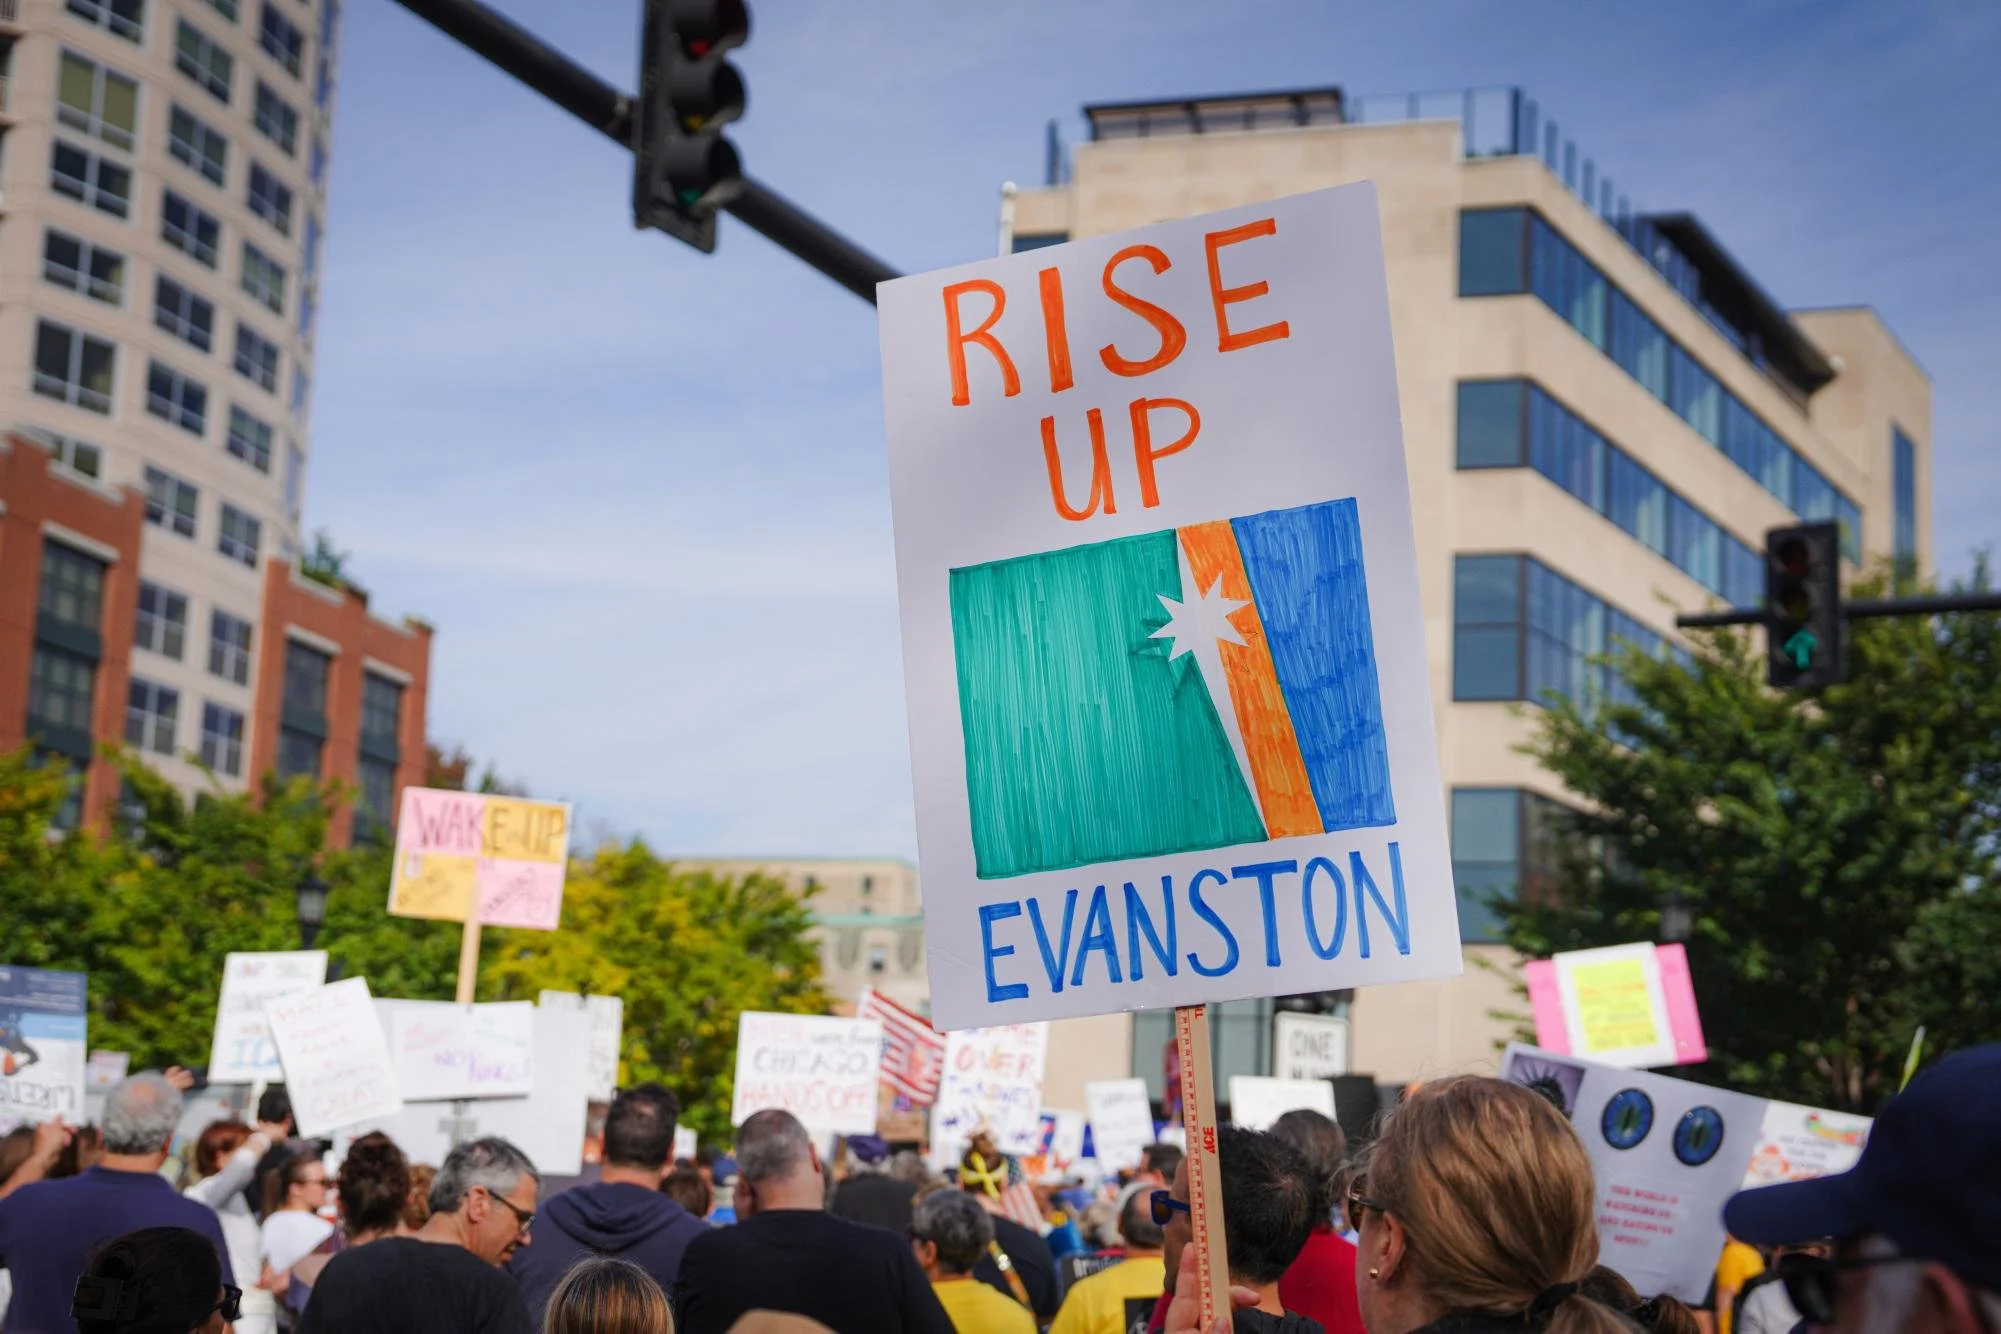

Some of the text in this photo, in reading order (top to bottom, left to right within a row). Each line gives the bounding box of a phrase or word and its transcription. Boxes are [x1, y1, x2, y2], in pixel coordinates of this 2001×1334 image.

[942, 218, 1290, 406] RISE
[1040, 397, 1201, 522] UP
[413, 797, 511, 856] WAKE
[979, 842, 1409, 1003] EVANSTON
[752, 1045, 869, 1076] CHICAGO
[1290, 1029, 1335, 1061] ONE
[1202, 1126, 1216, 1155] ACE
